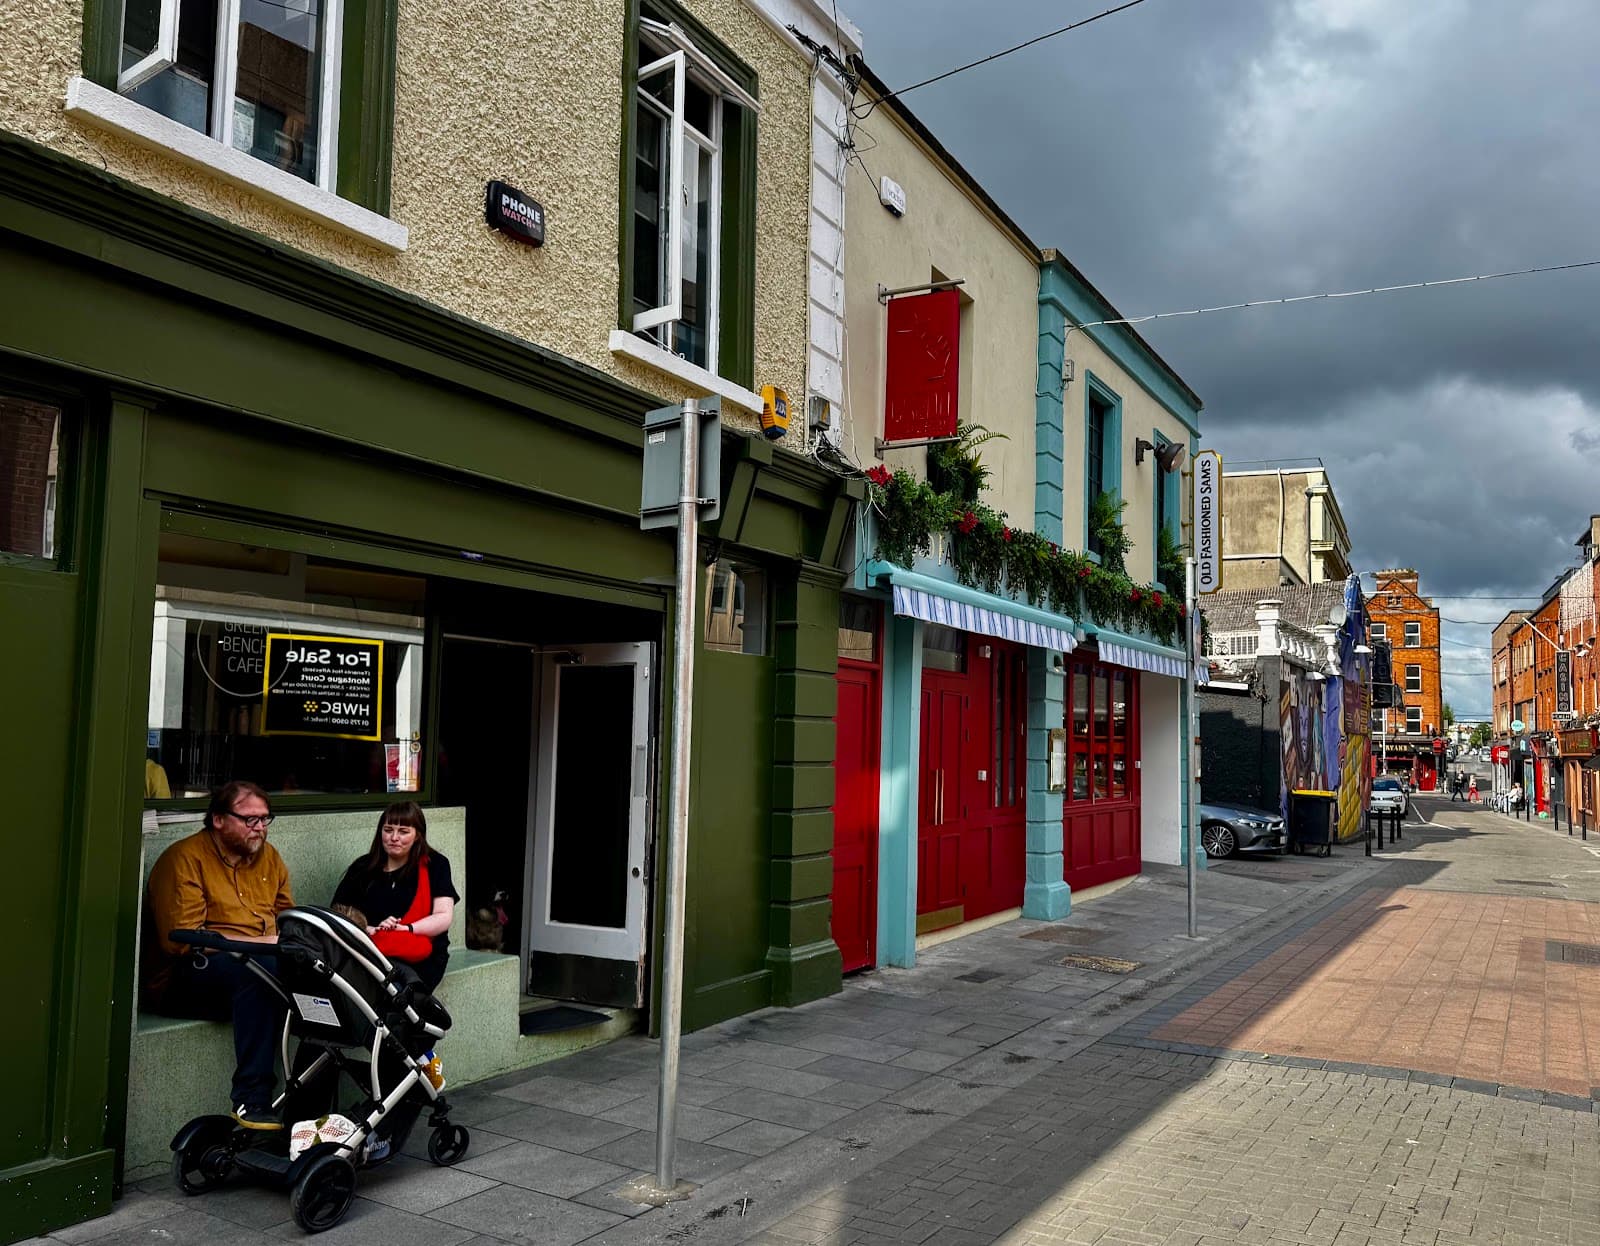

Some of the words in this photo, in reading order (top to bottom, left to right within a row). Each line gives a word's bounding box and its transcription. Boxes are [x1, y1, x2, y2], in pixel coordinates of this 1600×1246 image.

[502, 194, 541, 223] PHONE
[502, 207, 532, 228] WATCH
[1200, 495, 1212, 559] FASHIONED
[1200, 561, 1213, 585] OLD
[227, 656, 263, 673] CAFE
[1558, 653, 1569, 712] CASINO
